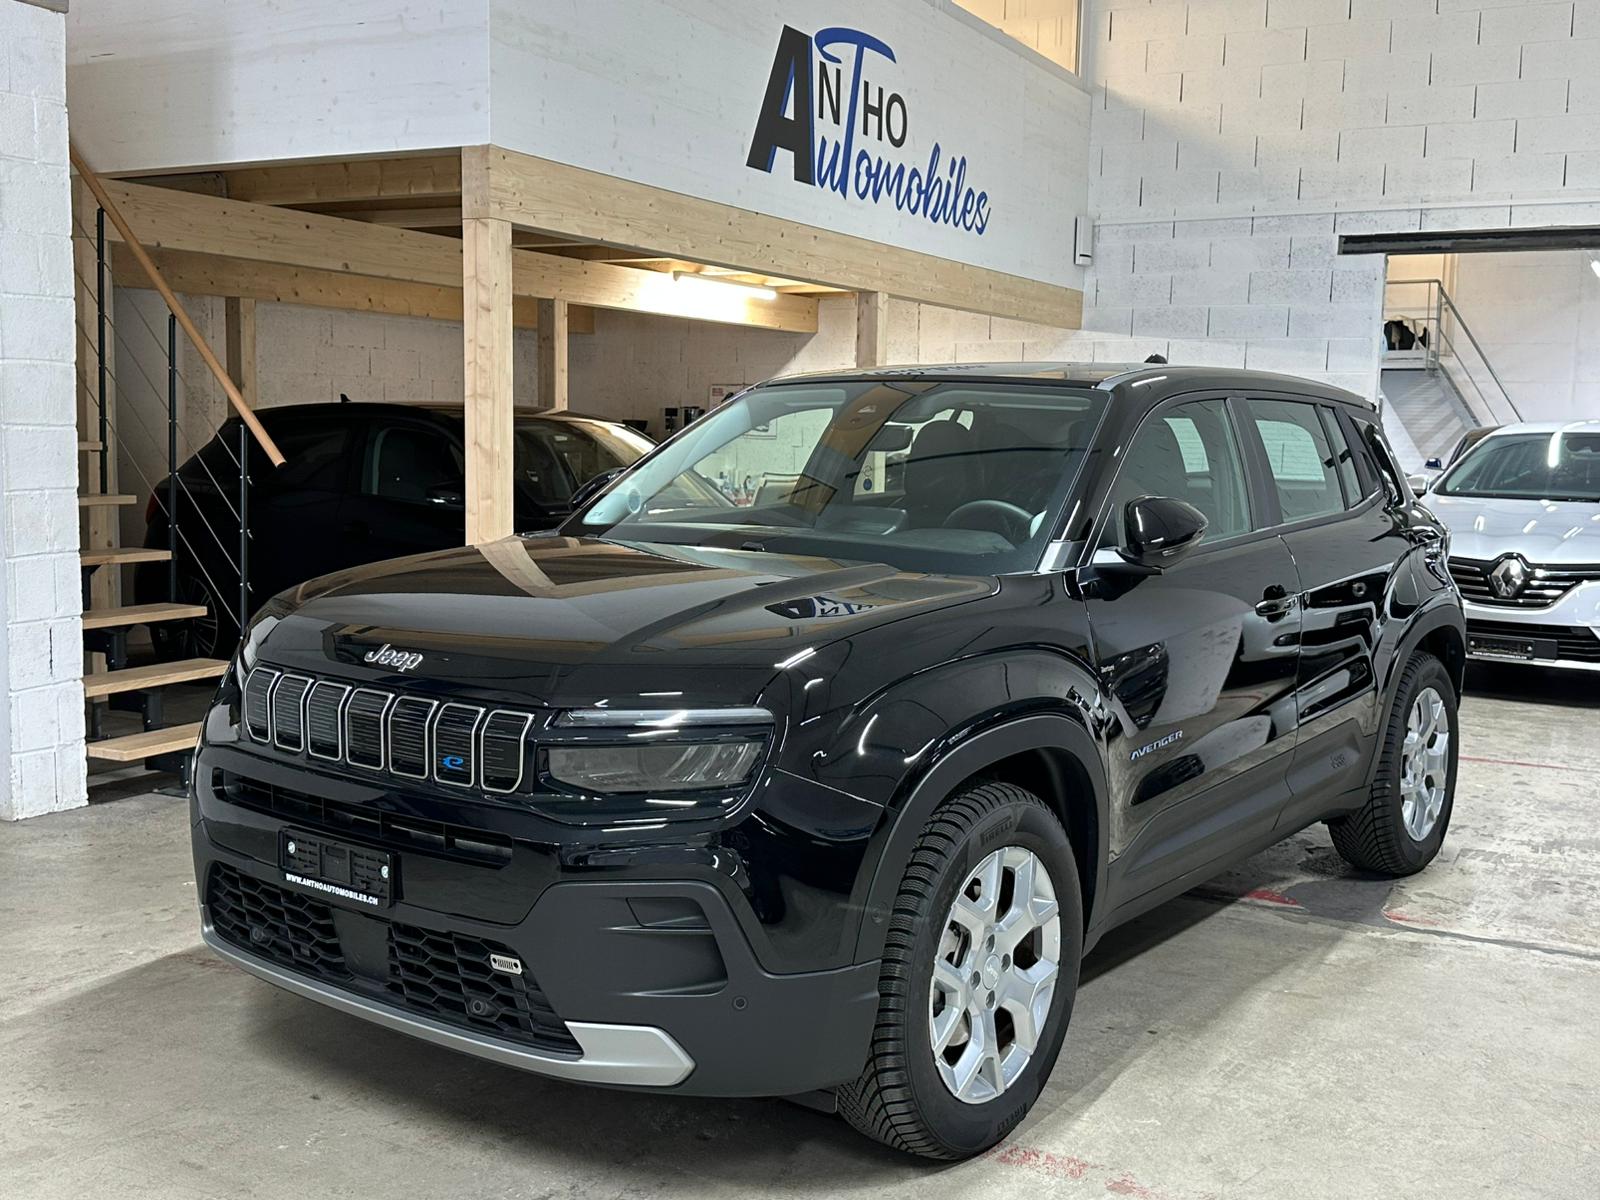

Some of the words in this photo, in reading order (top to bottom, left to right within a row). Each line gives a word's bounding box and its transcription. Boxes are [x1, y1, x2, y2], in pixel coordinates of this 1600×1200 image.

[364, 643, 424, 673] Jeep
[1130, 730, 1183, 761] AVENGER
[285, 872, 379, 906] WWW.ANTHOAUTOMOBILES.CH
